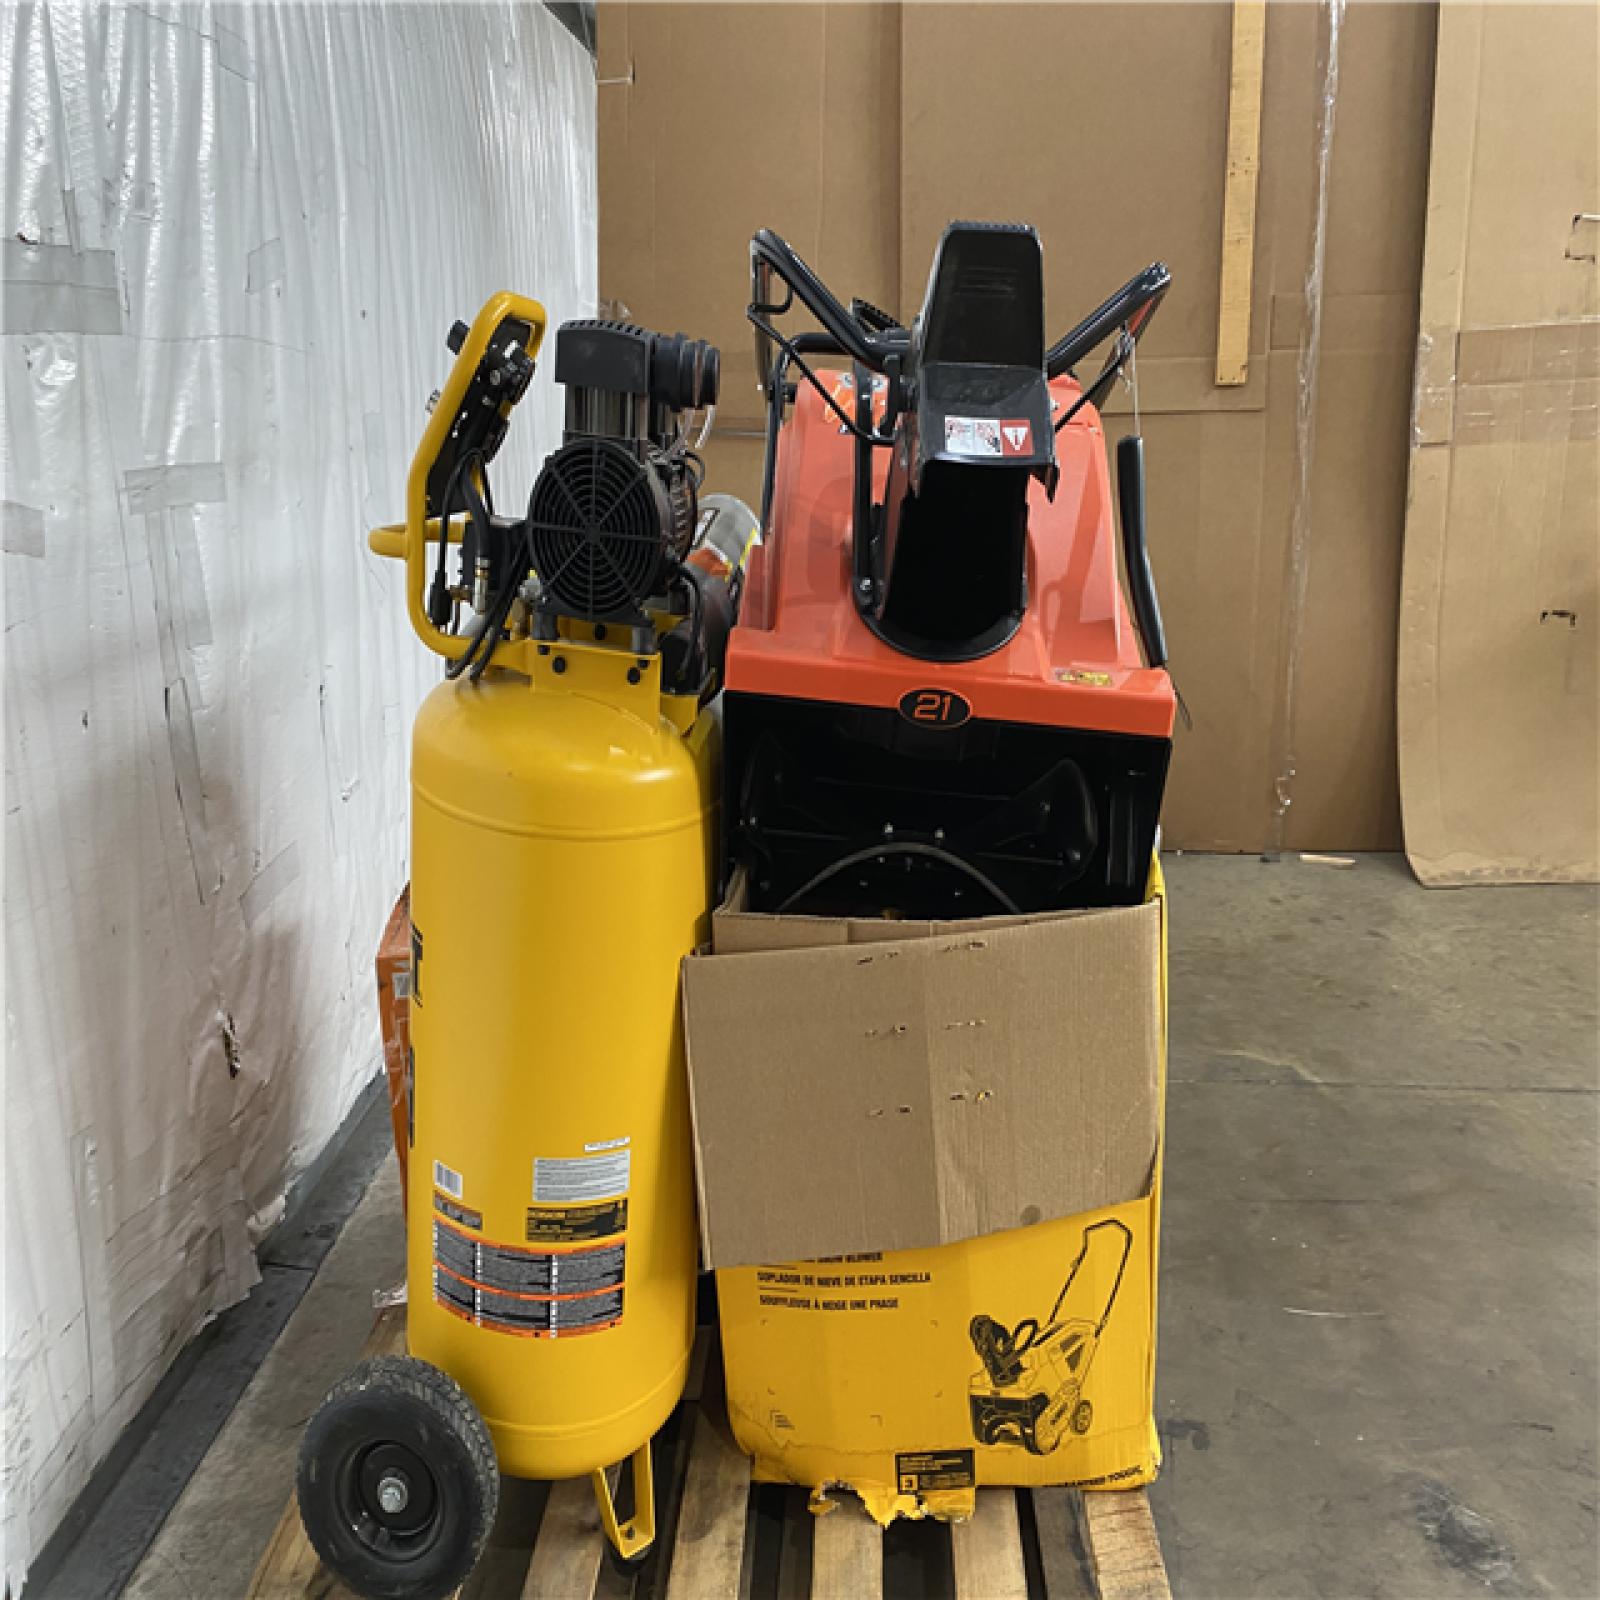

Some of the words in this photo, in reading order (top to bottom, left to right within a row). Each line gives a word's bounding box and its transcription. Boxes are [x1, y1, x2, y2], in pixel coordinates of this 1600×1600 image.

[913, 694, 951, 721] 21
[757, 1271, 801, 1284] SOPLADOR
[804, 1274, 814, 1285] DE
[817, 1276, 841, 1287] NIEVE
[844, 1276, 855, 1286] DE
[859, 1275, 886, 1286] ETAPA
[890, 1272, 931, 1284] SENCILLA
[759, 1295, 810, 1308] SOUFFLEUSE
[822, 1299, 846, 1310] NEIGE
[850, 1299, 866, 1310] UNE
[869, 1298, 898, 1308] PHASE
